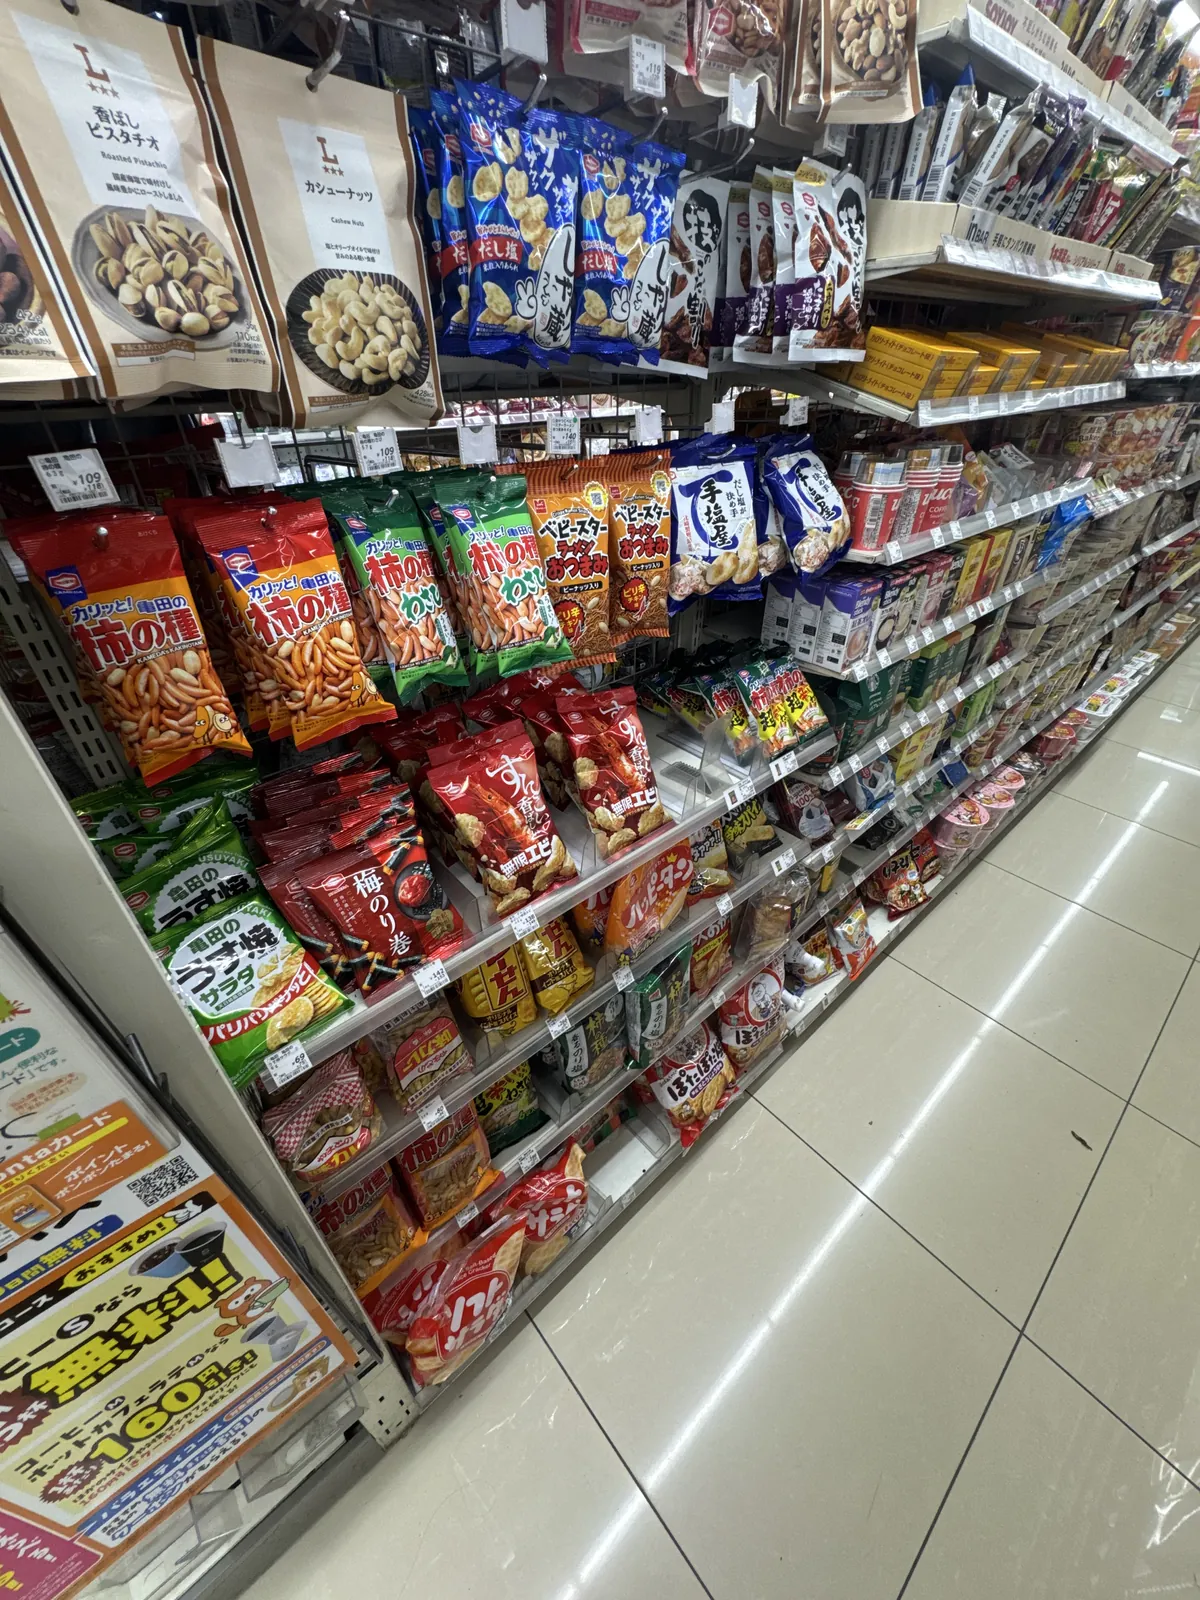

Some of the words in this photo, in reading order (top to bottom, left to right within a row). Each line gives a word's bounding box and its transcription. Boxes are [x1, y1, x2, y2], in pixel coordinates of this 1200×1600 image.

[73, 43, 110, 83] L
[92, 106, 139, 129] 香ばし
[86, 122, 159, 151] ピスタチオ
[316, 136, 339, 165] L
[101, 151, 132, 164] Roasted
[134, 157, 167, 169] Pistachio
[305, 180, 373, 203] カシューナッツ
[330, 216, 350, 226] Cashew
[351, 219, 365, 227] Nuts
[478, 240, 519, 261] だし塩
[376, 447, 394, 457] ¥109
[72, 472, 102, 486] ¥109
[726, 492, 737, 518] 決め手
[733, 479, 746, 515] だし塩が
[615, 504, 670, 523] ベビースター
[700, 478, 733, 548] 手塩屋
[538, 517, 608, 541] ベビースター
[627, 523, 658, 539] ラーメン
[468, 535, 539, 582] 柿の種
[557, 540, 594, 557] ラーメン
[619, 536, 669, 560] おつまみ
[301, 571, 340, 590] 亀田の
[364, 550, 434, 596] 柿の種
[546, 553, 609, 581] おつまみ
[632, 563, 661, 571] ピーナッツ入り
[563, 582, 600, 593] ピーナッツ入り
[623, 585, 645, 598] ピリ辛
[137, 596, 187, 613] 亀田の
[246, 582, 352, 647] 柿の種
[71, 607, 202, 673] 柿の種
[786, 692, 804, 713] 超
[611, 787, 658, 817] 無限エビ
[198, 853, 250, 868] USUYAKI
[500, 838, 553, 880] 無限エビ
[167, 867, 220, 902] 亀田の
[625, 857, 694, 929] ハッピーターン
[353, 869, 412, 957] 梅のり巻
[187, 918, 241, 954] 亀田の
[176, 922, 279, 995] うす焼
[200, 965, 256, 1008] サラダ
[292, 1053, 305, 1066] ¥69
[55, 1140, 152, 1200] ポンポンたまる!
[64, 1142, 128, 1182] ポイント
[75, 1221, 169, 1282] おすすめ!
[26, 1255, 240, 1406] 無料!
[100, 1424, 222, 1519] バラエティコース
